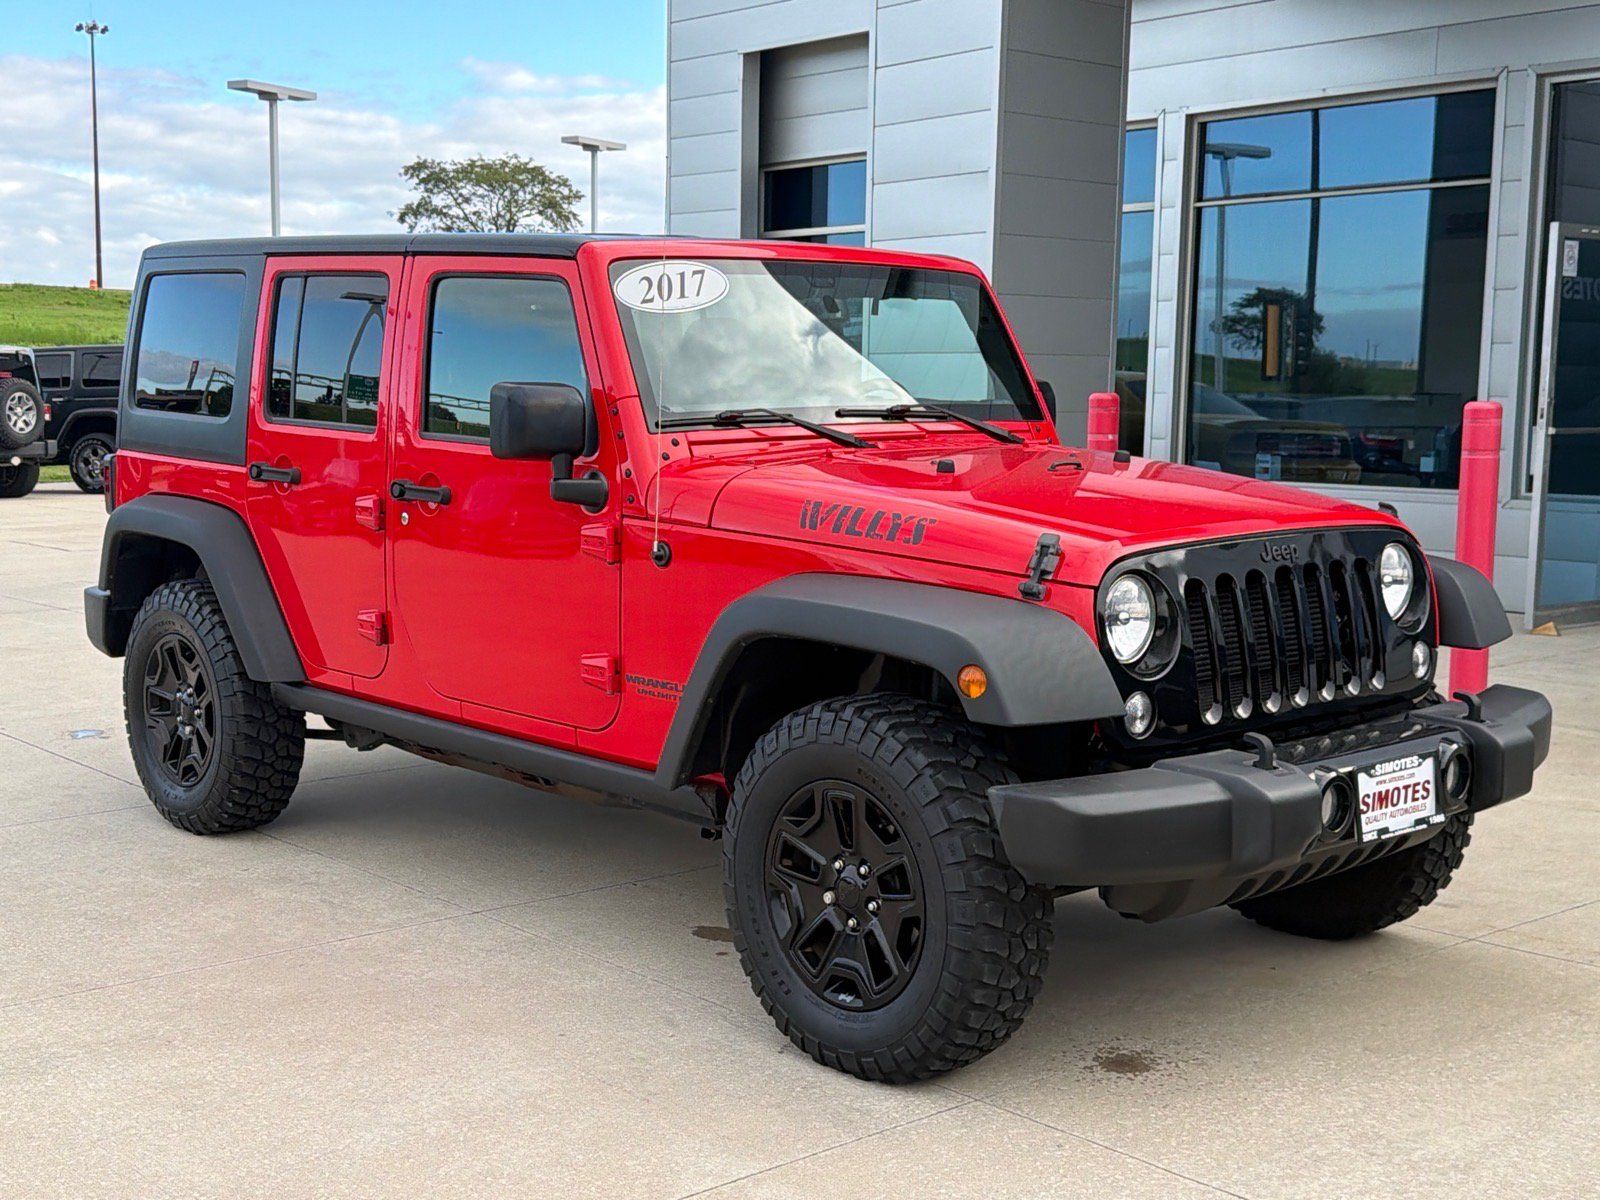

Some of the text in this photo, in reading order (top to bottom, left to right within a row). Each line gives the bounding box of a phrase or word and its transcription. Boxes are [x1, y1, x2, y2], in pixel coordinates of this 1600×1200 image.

[639, 269, 706, 304] 2017
[800, 500, 937, 545] WILLYS
[1260, 541, 1299, 567] Jeep
[626, 674, 685, 692] WRANGL
[1375, 755, 1419, 776] SIMOTES
[1360, 779, 1431, 815] SIMOTES
[1365, 812, 1388, 826] QUALITY
